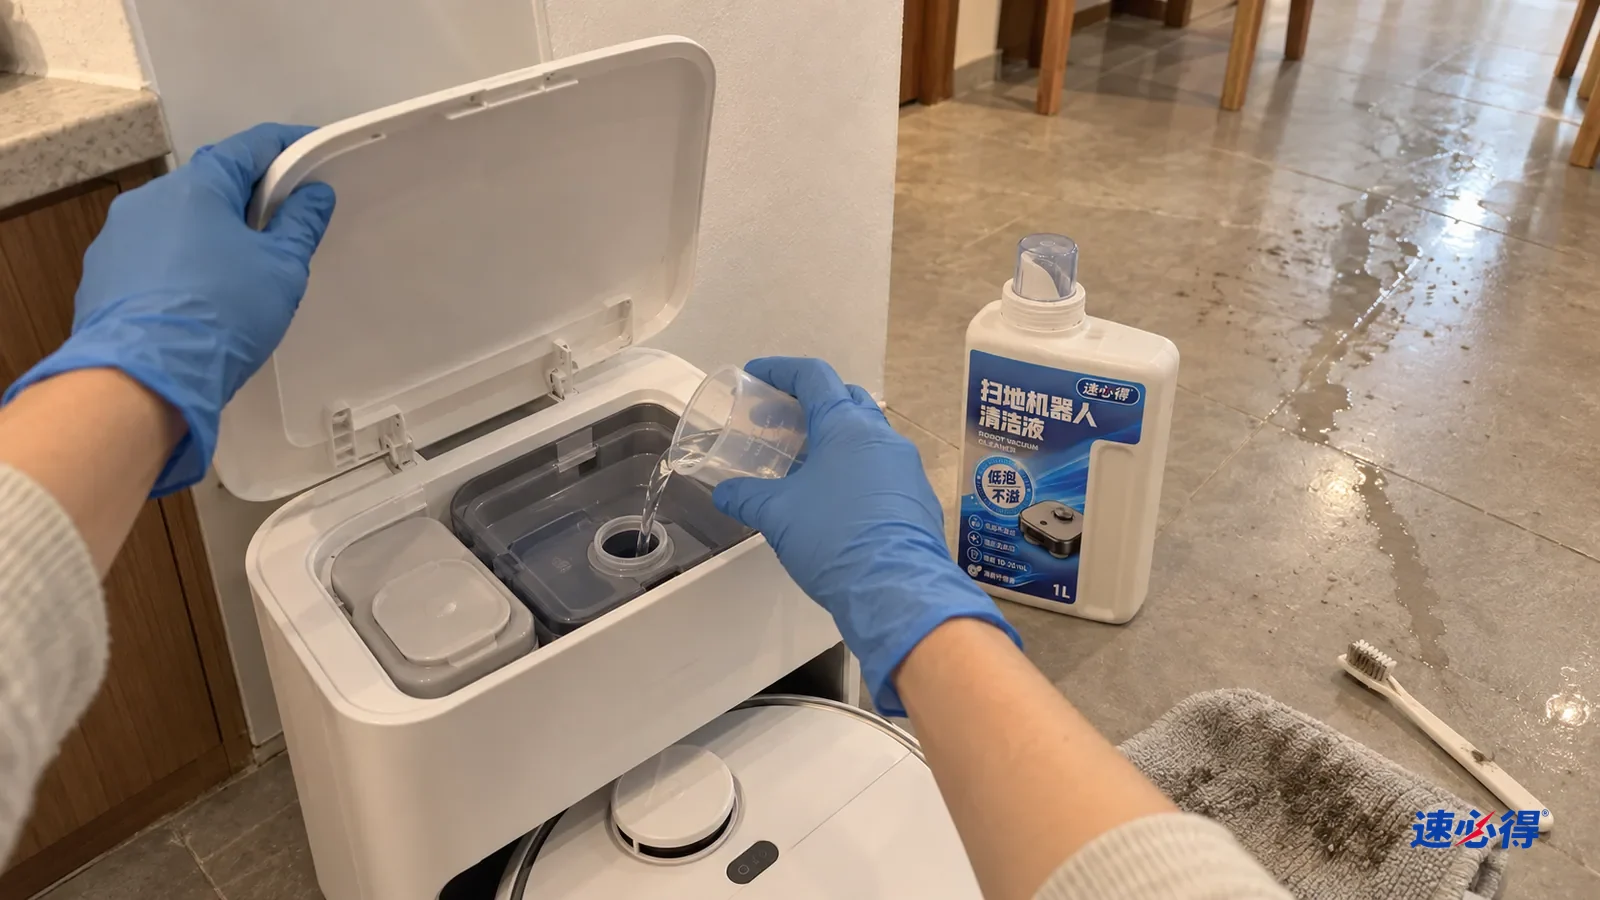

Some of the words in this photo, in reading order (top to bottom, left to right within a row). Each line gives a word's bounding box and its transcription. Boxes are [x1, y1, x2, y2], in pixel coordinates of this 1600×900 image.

[980, 378, 1098, 428] 扫地机器人
[978, 404, 1045, 441] 清洁液
[987, 469, 1017, 485] 低泡
[991, 488, 1020, 504] 不溢
[1052, 583, 1071, 599] 1L
